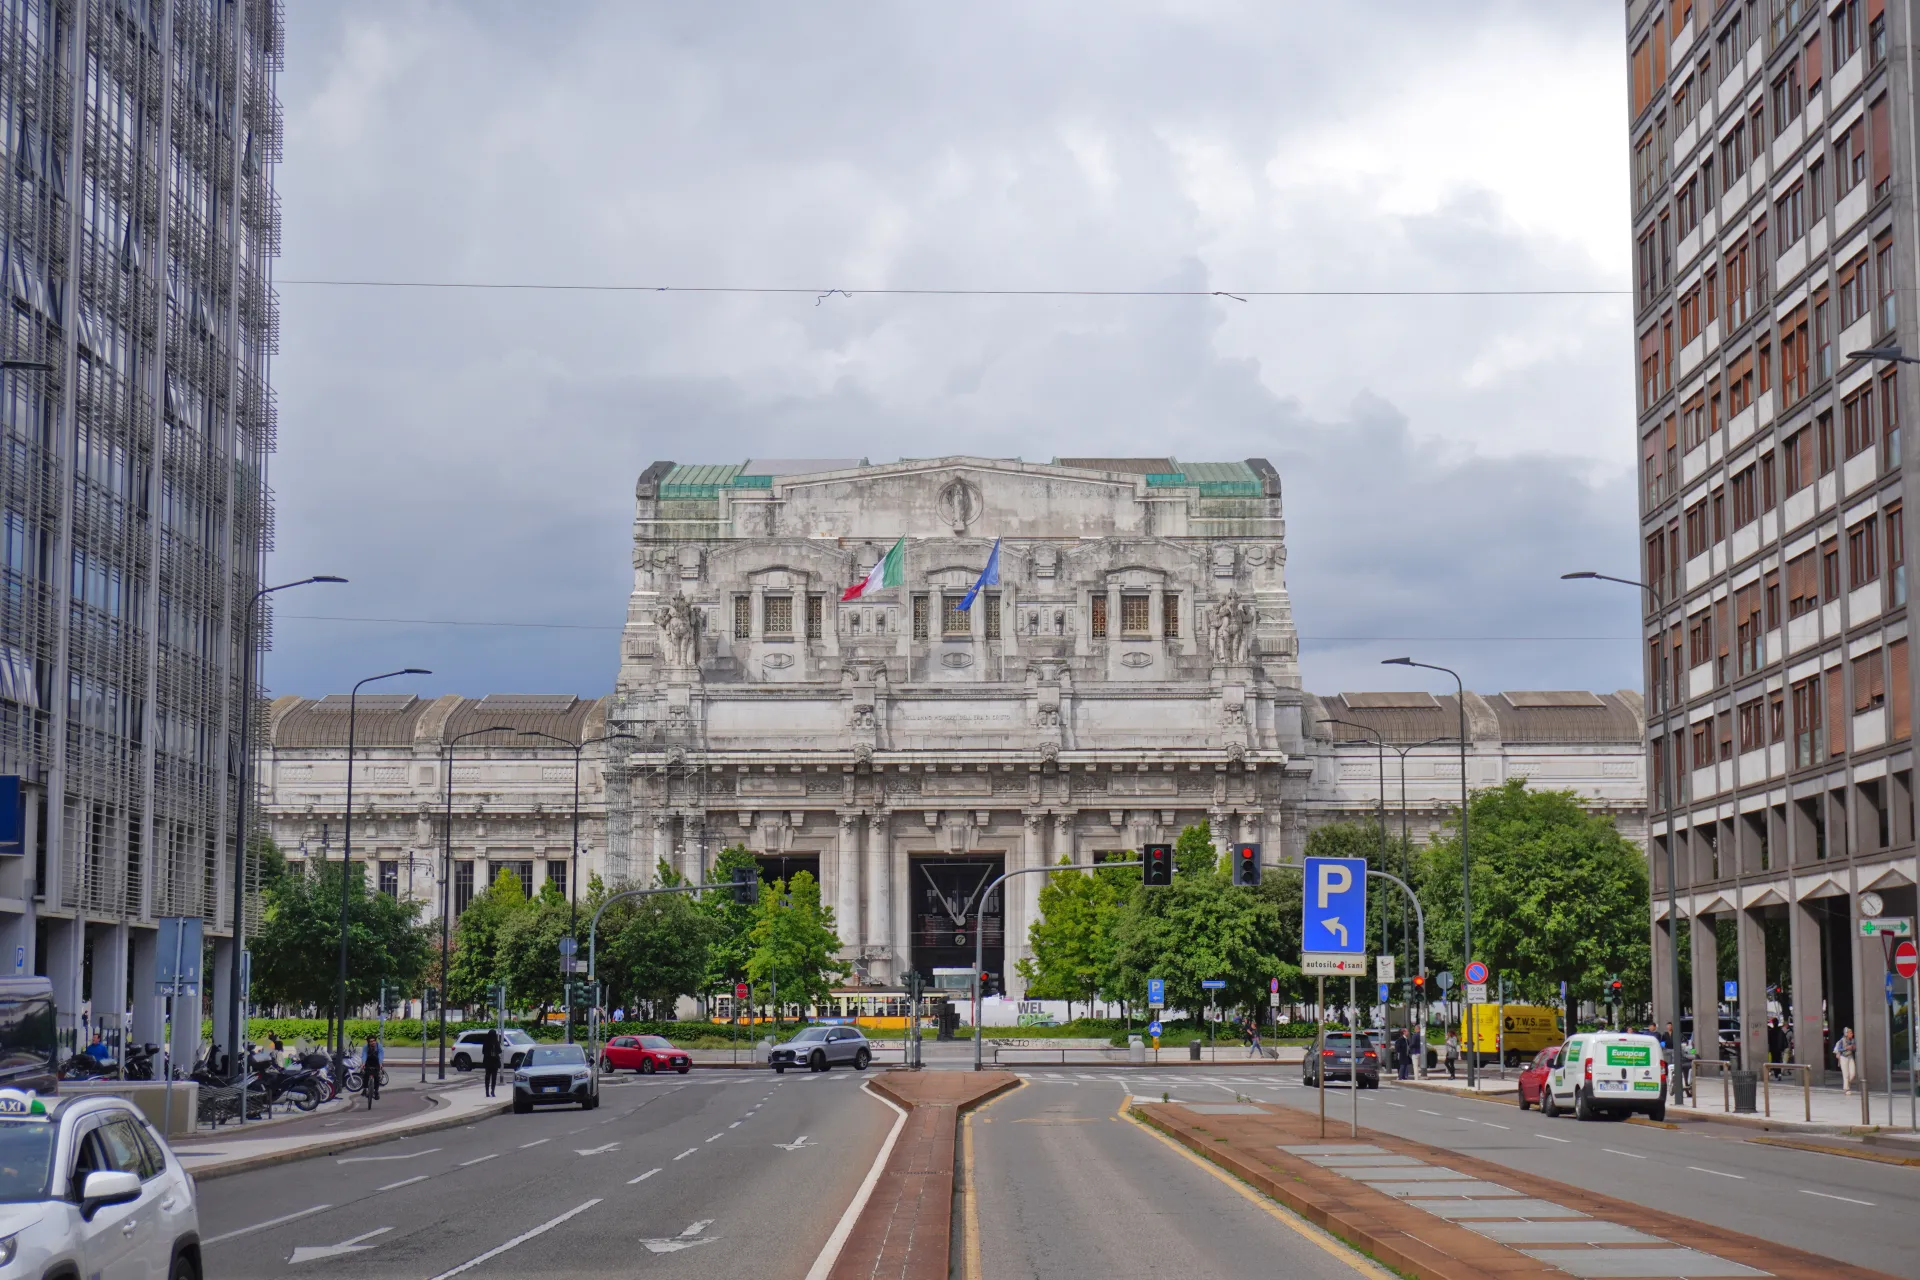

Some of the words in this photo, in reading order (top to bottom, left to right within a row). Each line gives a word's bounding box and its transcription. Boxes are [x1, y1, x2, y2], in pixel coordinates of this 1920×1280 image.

[1318, 865, 1352, 908] P
[1306, 960, 1337, 968] autosilo
[1152, 982, 1160, 992] P
[1017, 1002, 1045, 1014] WEL
[1515, 1017, 1537, 1026] T.W.S.
[1611, 1049, 1647, 1059] Europcar
